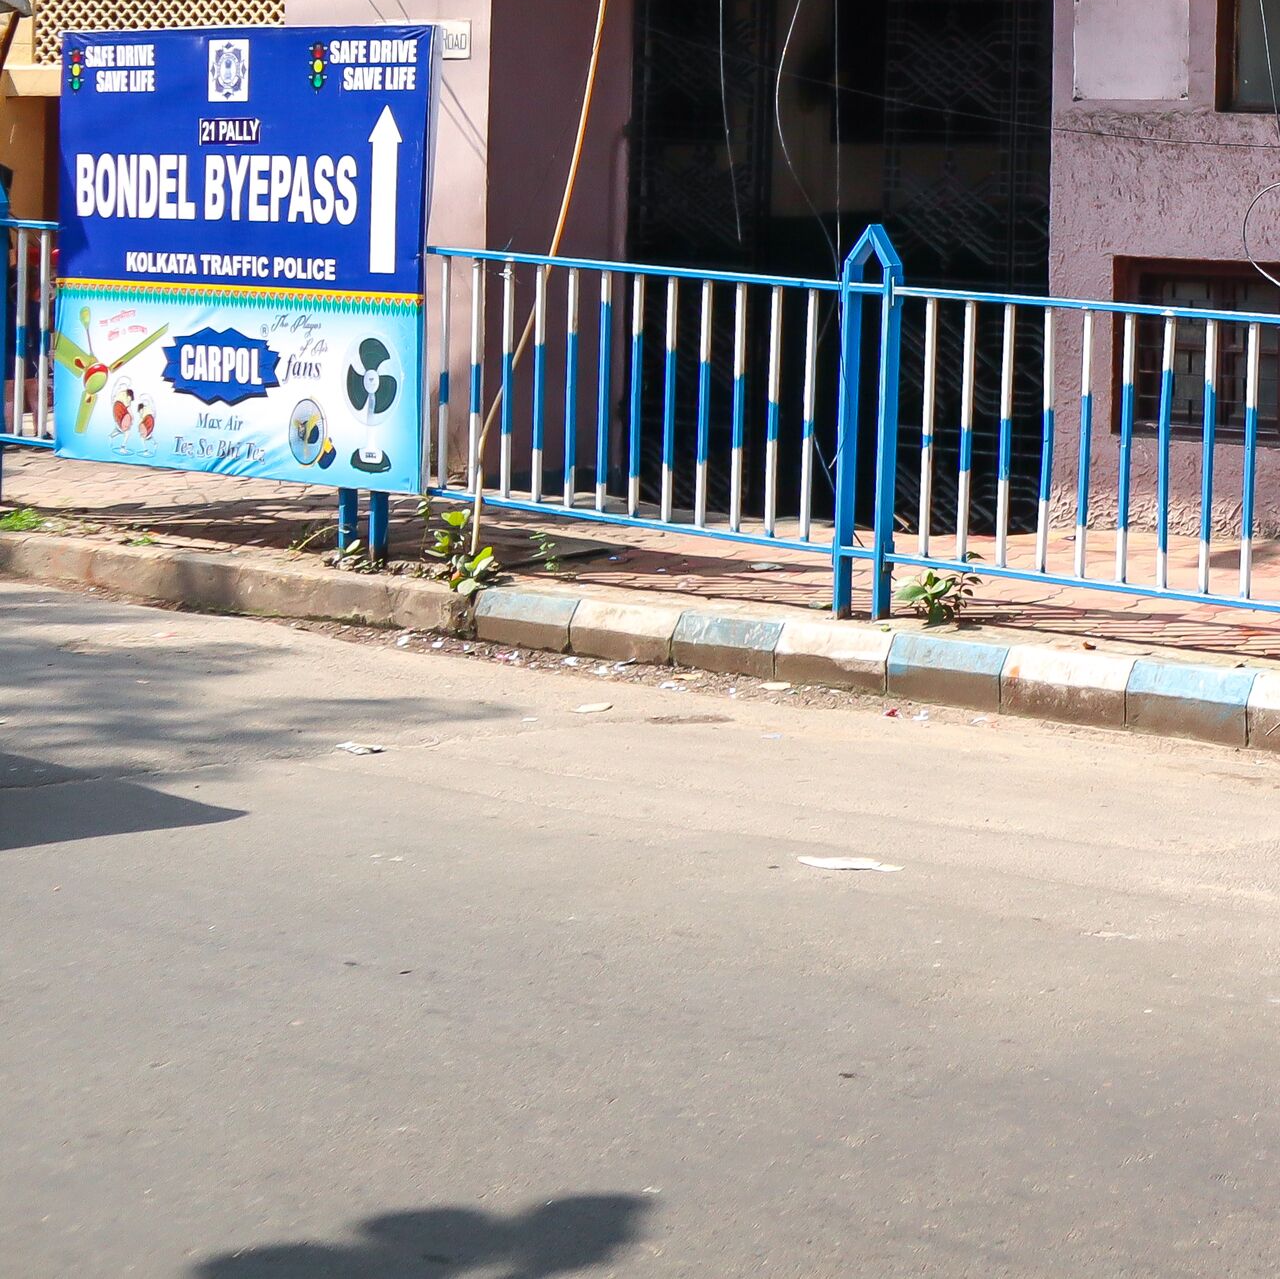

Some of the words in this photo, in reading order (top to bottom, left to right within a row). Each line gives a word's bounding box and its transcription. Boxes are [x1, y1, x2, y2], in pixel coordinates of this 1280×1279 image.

[84, 44, 115, 68] SAFE
[116, 44, 156, 67] DRIVE
[329, 40, 367, 64] SAFE
[369, 39, 418, 64] DRIVE
[95, 70, 128, 93] SAVE
[129, 69, 156, 92] LIFE
[343, 67, 382, 91] SAVE
[384, 66, 416, 91] LIFE
[202, 121, 215, 141] 21
[218, 120, 259, 141] PALLY
[76, 153, 196, 220] BONDEL
[204, 154, 358, 225] BYEPASS
[126, 251, 197, 275] KOLKATA
[200, 254, 269, 278] TRAFFIC
[273, 257, 336, 281] POLICE
[180, 344, 262, 386] CARPOL
[282, 354, 322, 382] fans
[196, 413, 222, 430] Max
[224, 415, 243, 431] Air
